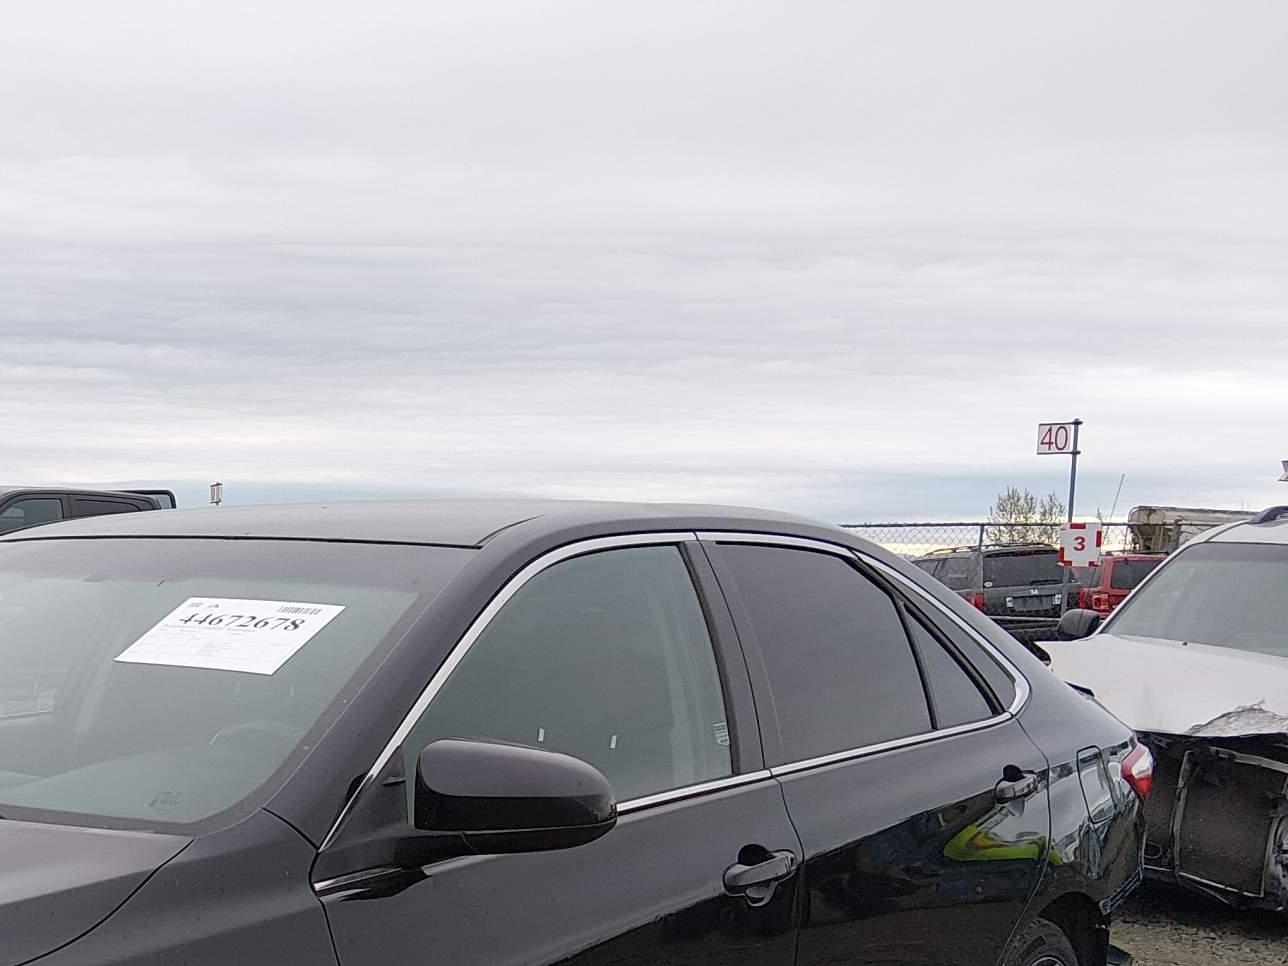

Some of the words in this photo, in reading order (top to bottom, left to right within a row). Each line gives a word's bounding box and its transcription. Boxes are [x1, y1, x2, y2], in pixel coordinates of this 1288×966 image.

[1039, 425, 1068, 451] 40
[1073, 536, 1086, 551] 3
[178, 612, 307, 632] 44672678
